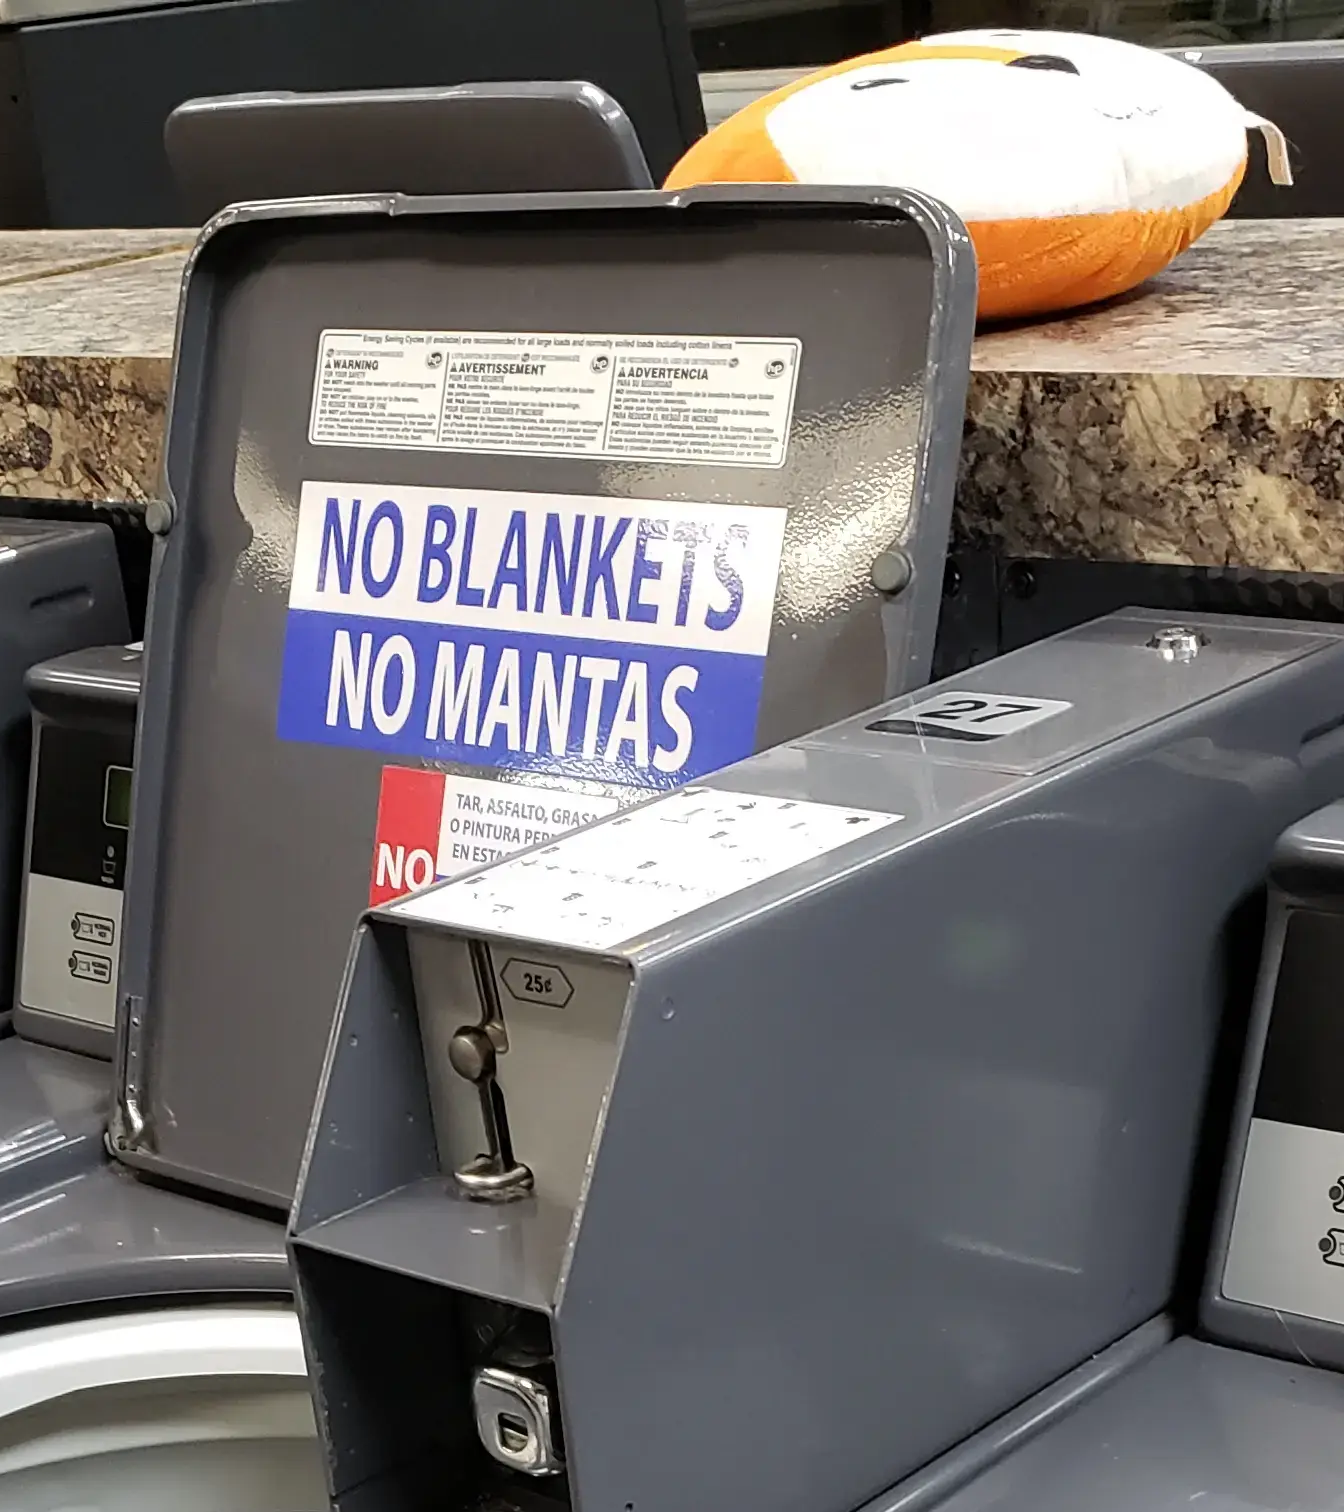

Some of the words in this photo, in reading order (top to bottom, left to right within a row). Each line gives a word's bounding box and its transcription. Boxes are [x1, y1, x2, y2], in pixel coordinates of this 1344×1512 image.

[334, 360, 379, 371] WARNING
[459, 363, 546, 376] AVERTISSEMENT
[628, 367, 709, 380] ADVERTENCIA
[316, 498, 404, 598] NO
[417, 505, 750, 631] BLANKETS
[326, 631, 416, 735] NO
[425, 640, 699, 773] MANTAS
[919, 700, 1043, 723] 27
[457, 794, 482, 814] TAR,
[487, 798, 548, 824] ASFALTO,
[450, 818, 459, 832] O
[463, 820, 520, 844] PINTURA
[452, 844, 470, 859] EN
[376, 843, 433, 892] NO
